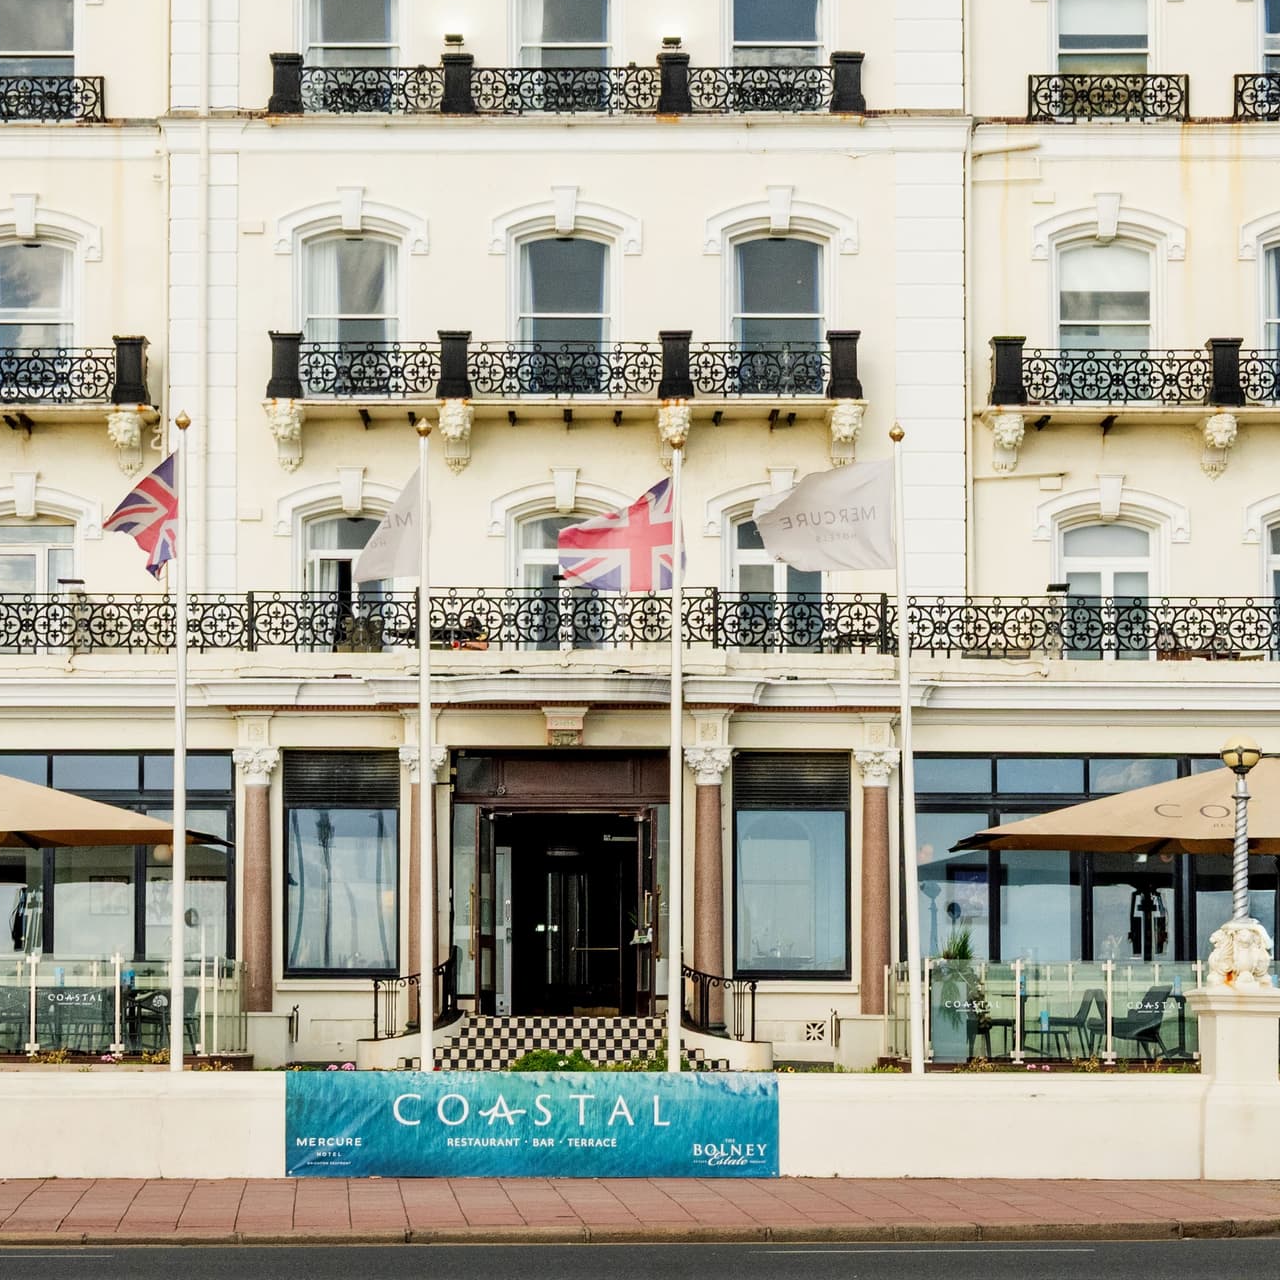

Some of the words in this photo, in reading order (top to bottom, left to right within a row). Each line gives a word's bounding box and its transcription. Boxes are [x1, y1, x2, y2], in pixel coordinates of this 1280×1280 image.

[48, 994, 102, 1002] COASTAL
[944, 1000, 1000, 1008] COASTAL
[1127, 1001, 1182, 1009] COASTAL
[393, 1094, 670, 1126] COASTAL
[296, 1137, 362, 1146] MERCURE
[447, 1138, 519, 1147] RESTAURANT
[532, 1138, 554, 1147] BAR
[568, 1138, 617, 1147] TERRACE
[693, 1143, 767, 1156] BOLNEY
[708, 1152, 748, 1166] Estate
